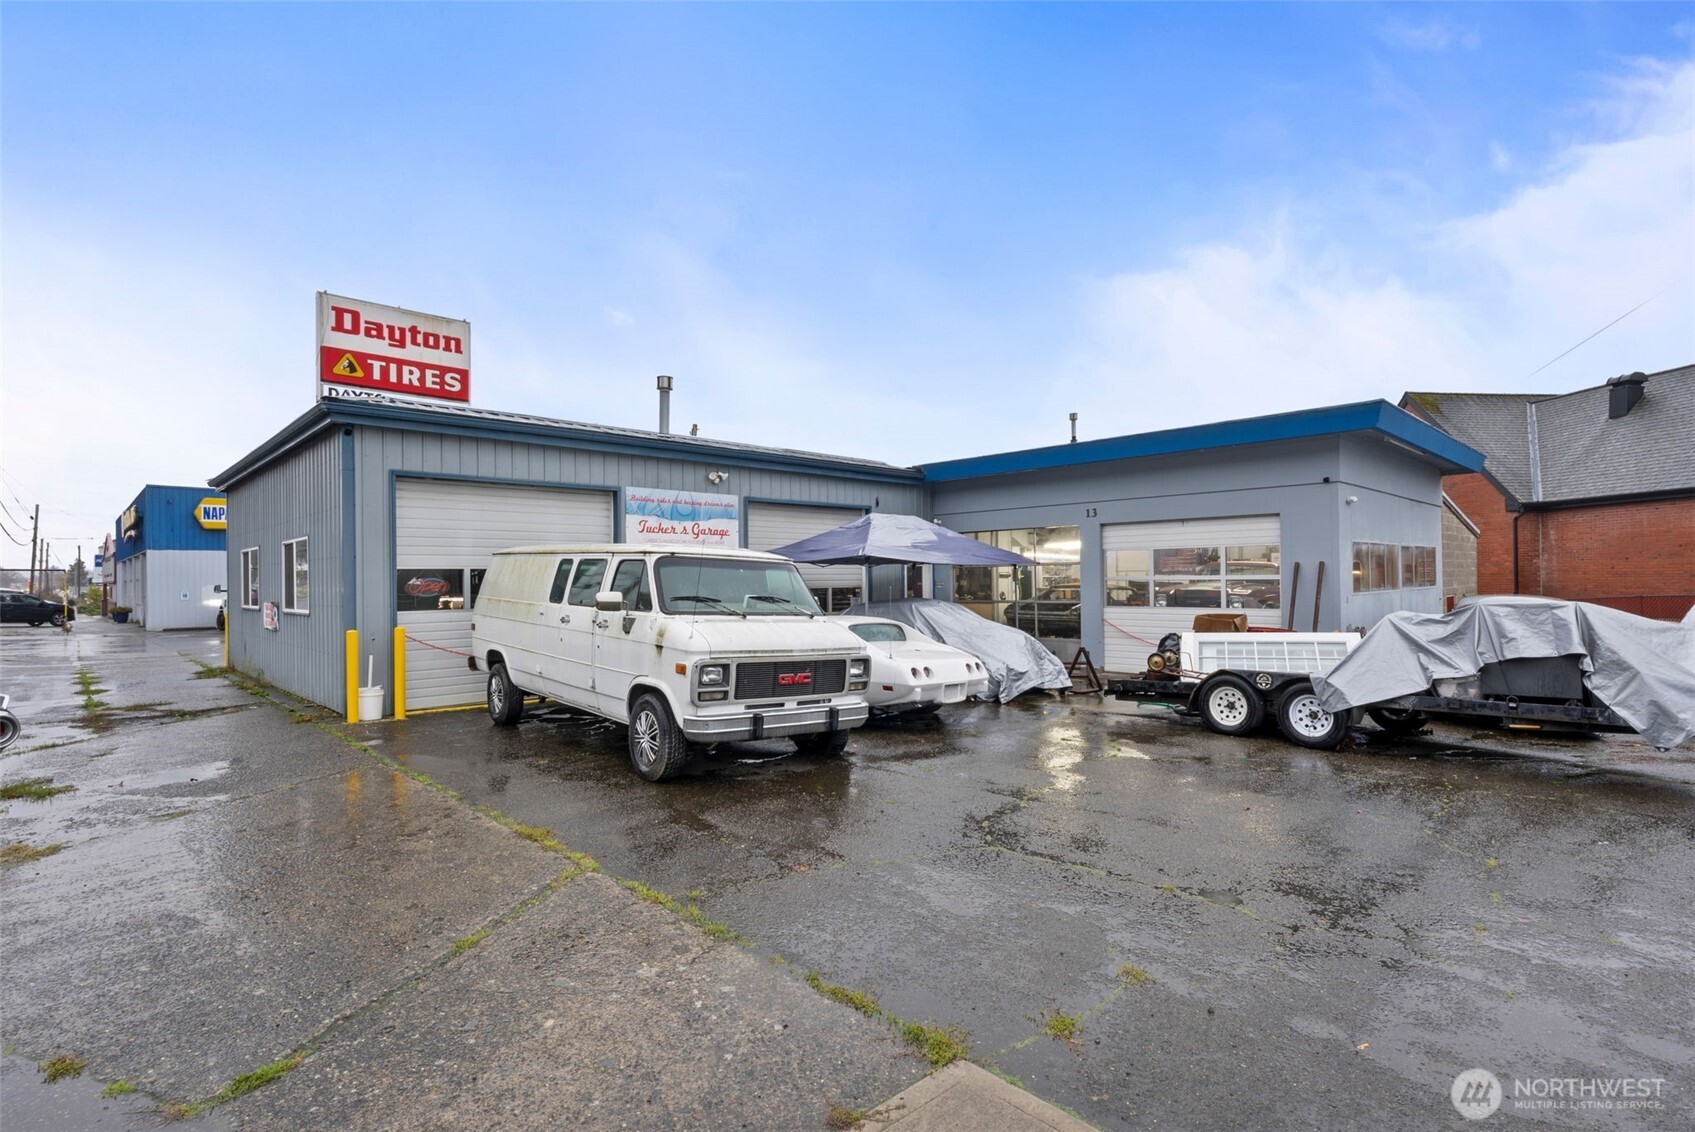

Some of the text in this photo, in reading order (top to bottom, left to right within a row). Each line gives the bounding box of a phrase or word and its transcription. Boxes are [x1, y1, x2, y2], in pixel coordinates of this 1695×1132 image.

[331, 305, 463, 354] Dayton
[367, 359, 461, 392] TIRES
[203, 506, 227, 520] NAP
[1086, 508, 1098, 518] 13
[692, 522, 730, 540] Garage
[778, 672, 812, 685] GMC
